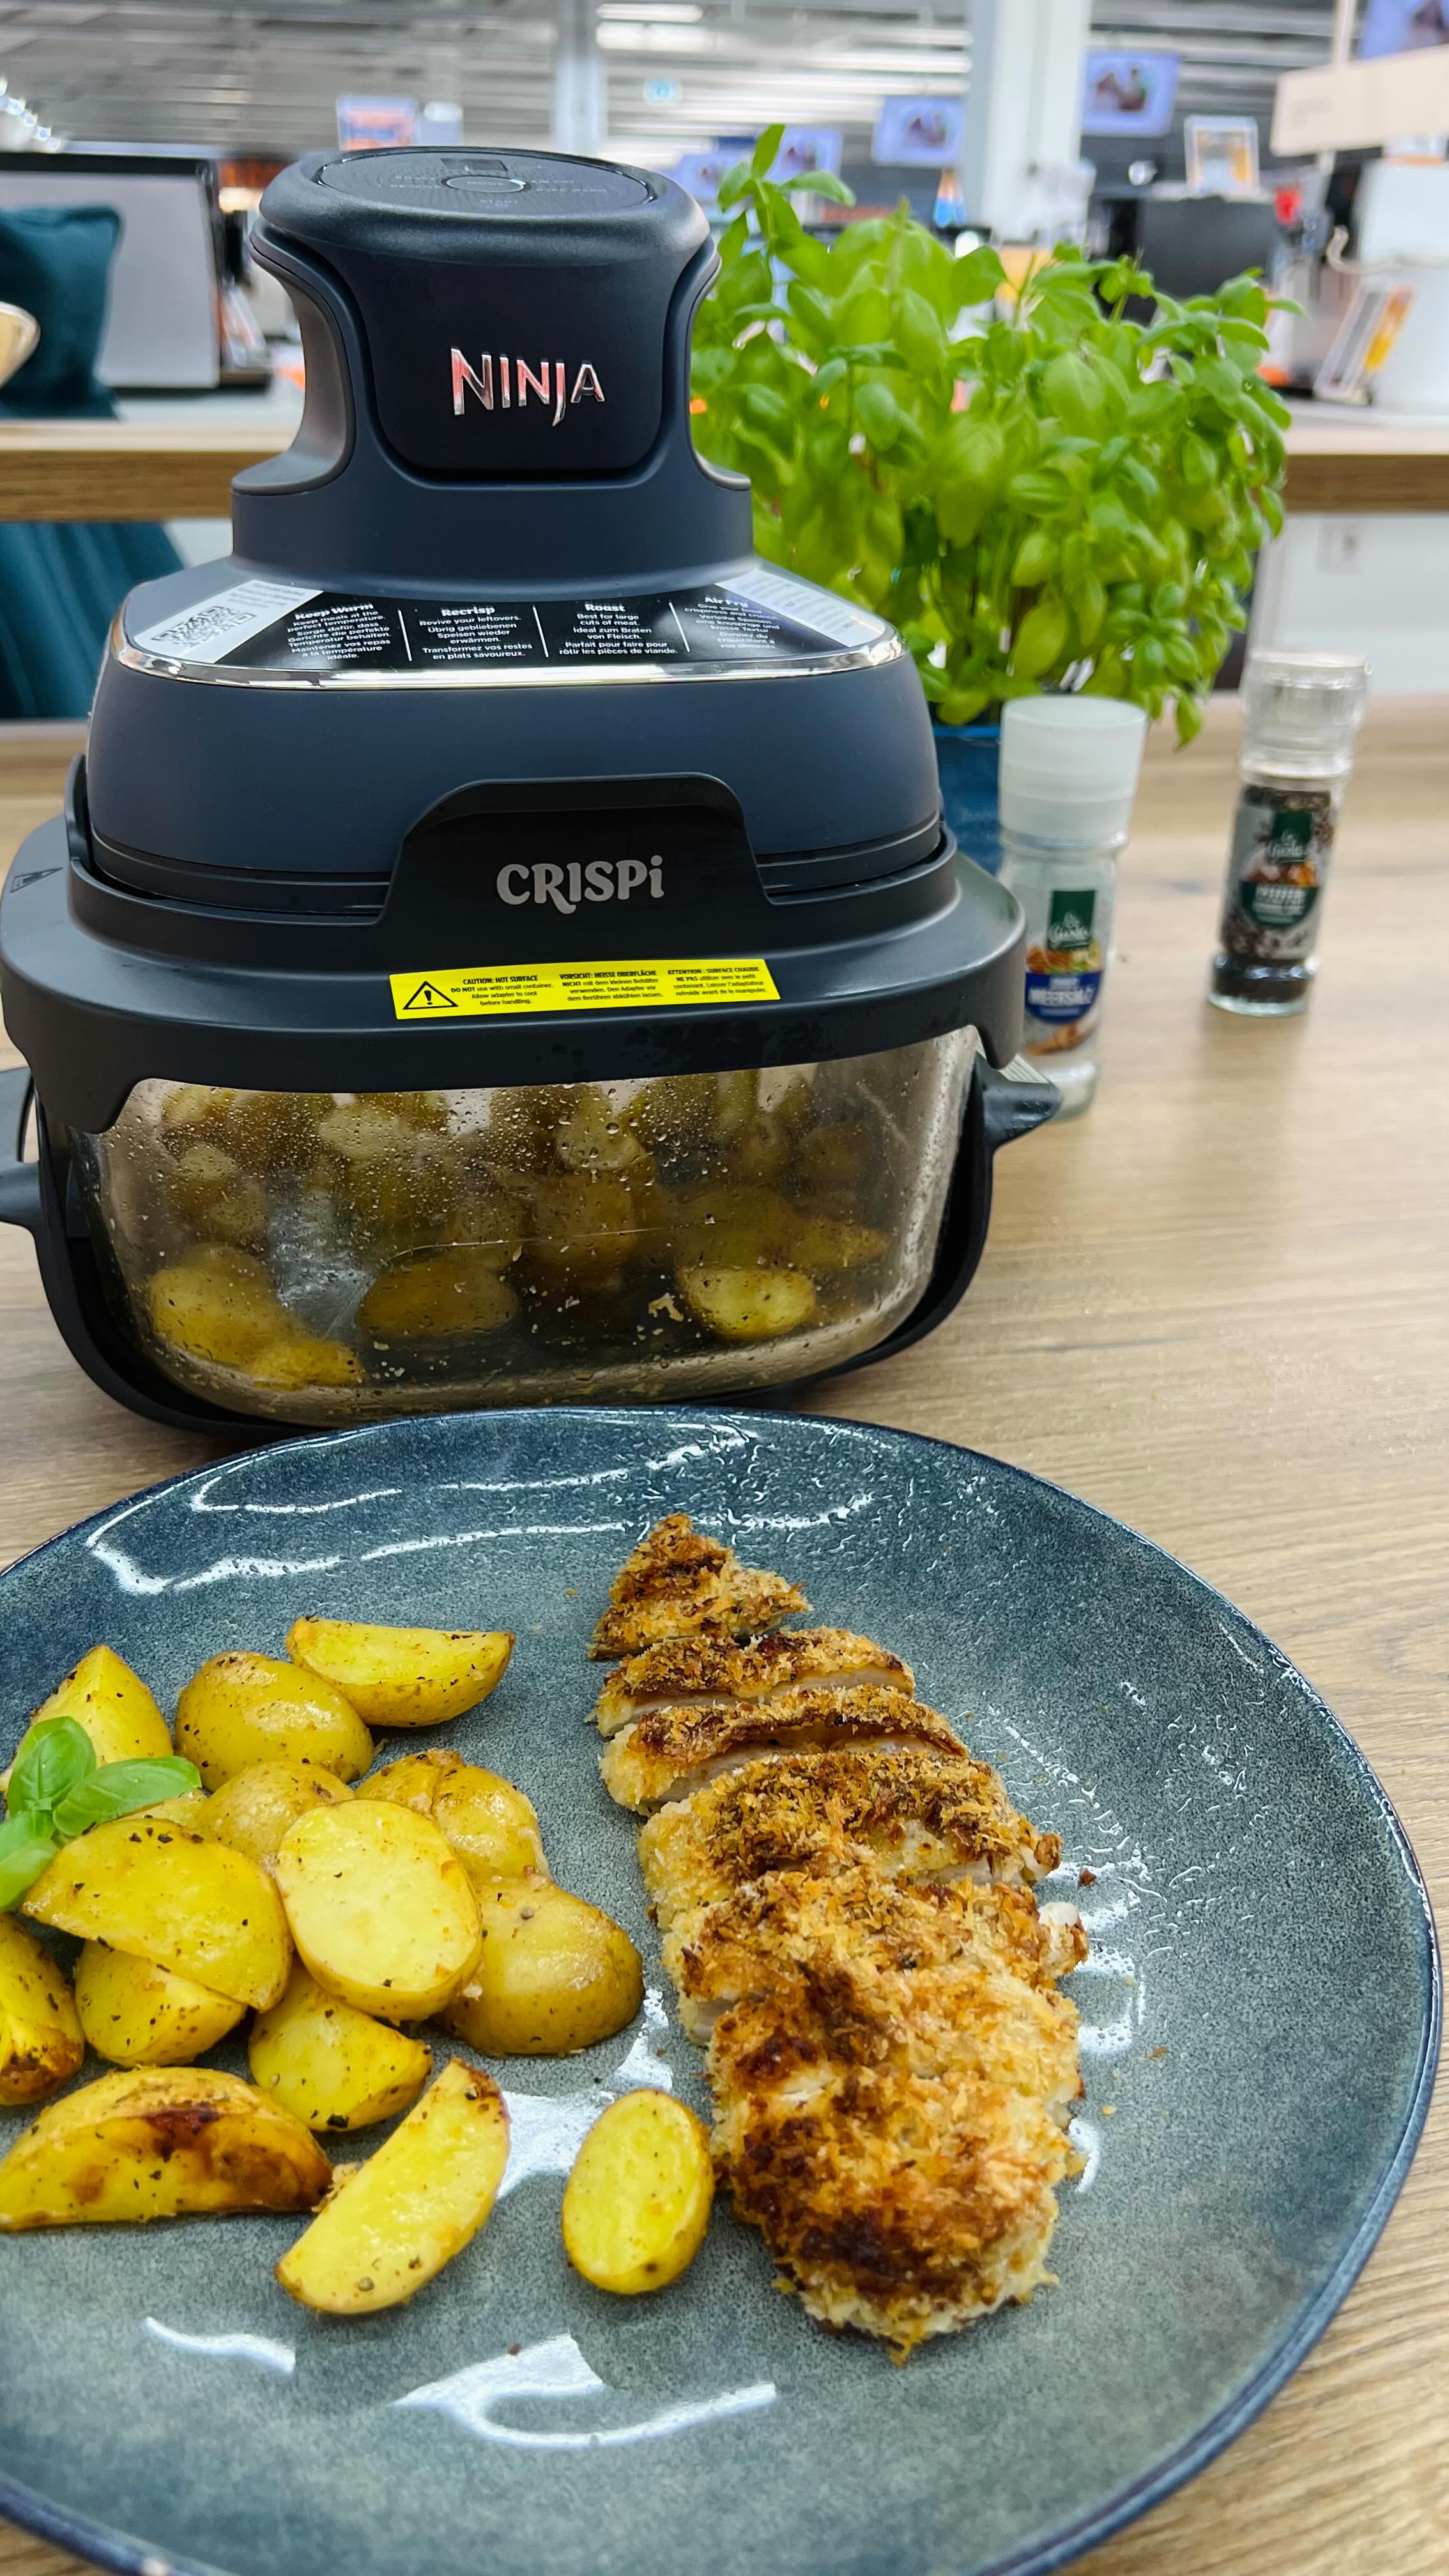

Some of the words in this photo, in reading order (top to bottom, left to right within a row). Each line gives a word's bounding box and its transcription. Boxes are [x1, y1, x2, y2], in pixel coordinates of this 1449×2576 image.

[450, 347, 604, 427] NINJA
[441, 606, 495, 617] Recrisp
[585, 603, 625, 611] Roast
[295, 610, 330, 620] Keep
[331, 604, 374, 613] Warm
[288, 623, 321, 632] perfect
[349, 626, 390, 634] perfekte
[457, 623, 517, 632] gebliebenen
[422, 645, 482, 654] Transformez
[496, 855, 664, 914] CRISPi
